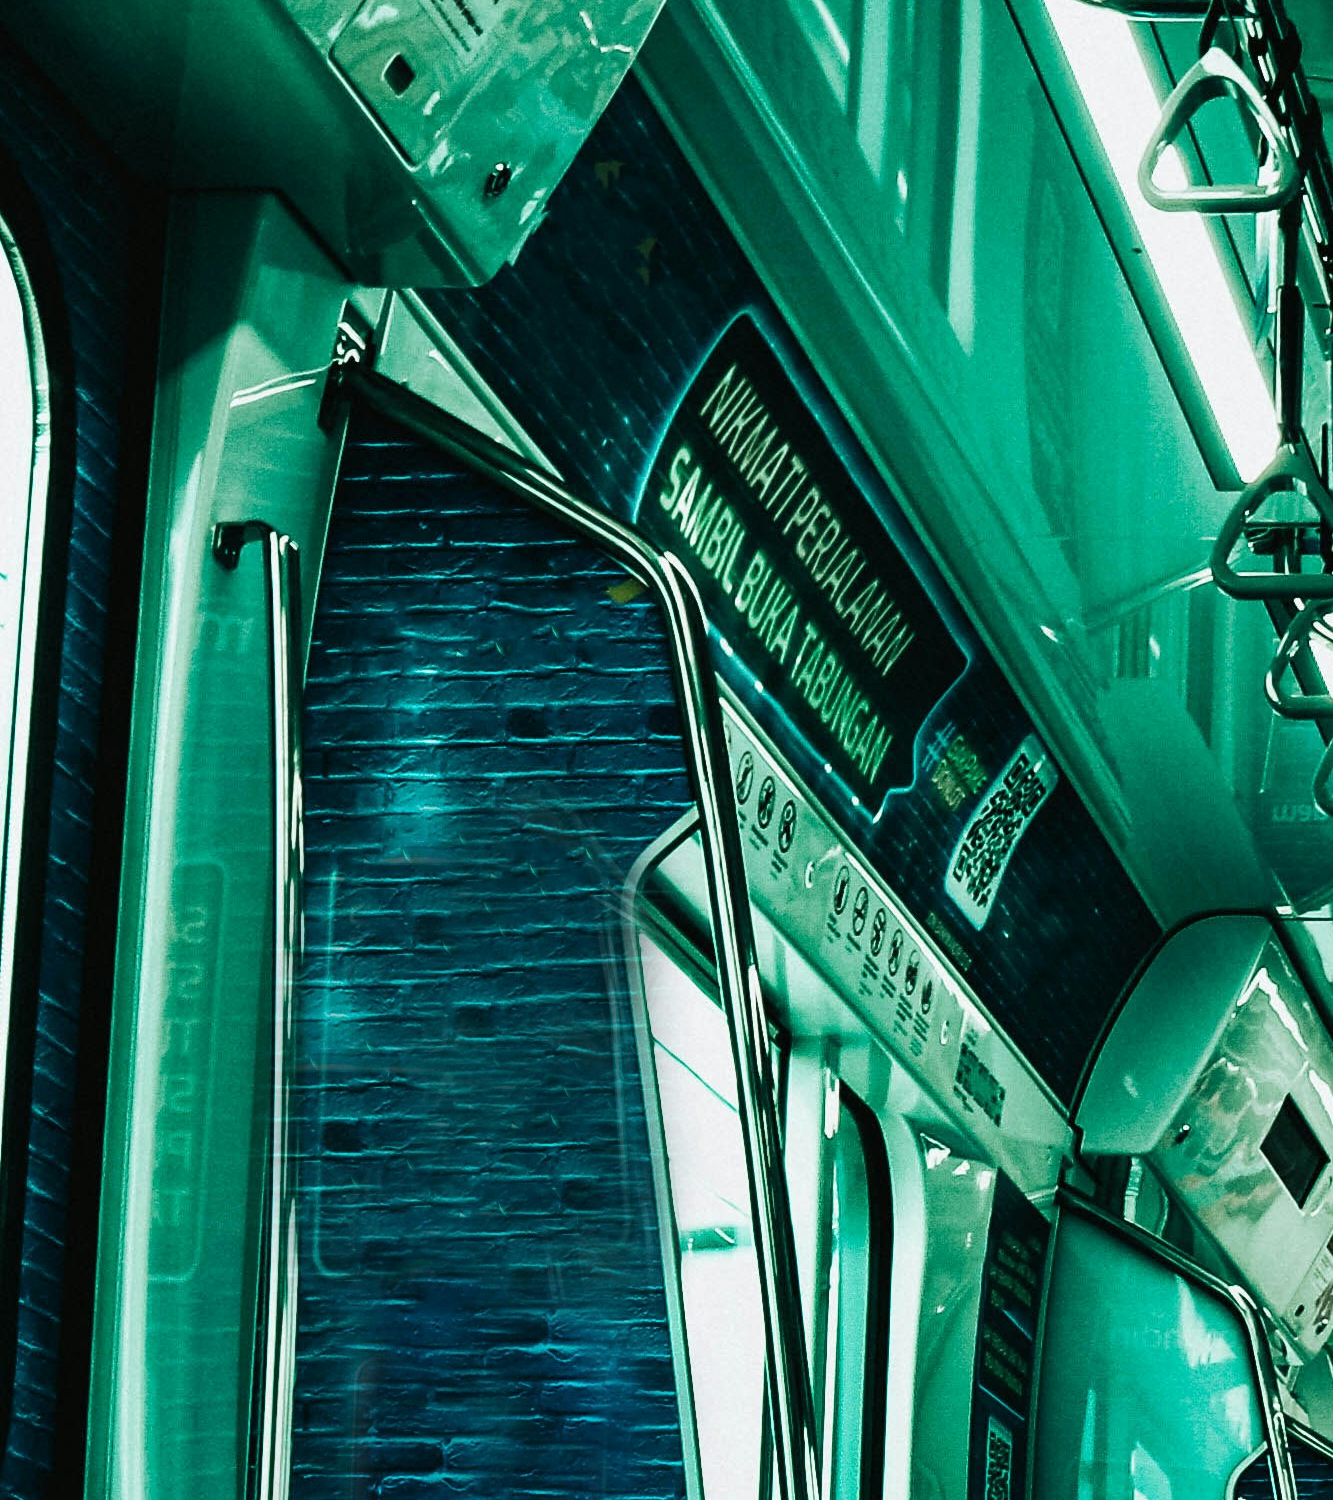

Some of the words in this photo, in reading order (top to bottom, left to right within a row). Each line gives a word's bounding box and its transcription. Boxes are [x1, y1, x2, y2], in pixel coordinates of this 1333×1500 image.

[660, 446, 746, 595] SAMBIL
[734, 550, 799, 665] BUKA
[791, 621, 894, 785] TABUNGAN
[700, 362, 808, 522] NIKMATI
[783, 485, 915, 677] PERJALANAN
